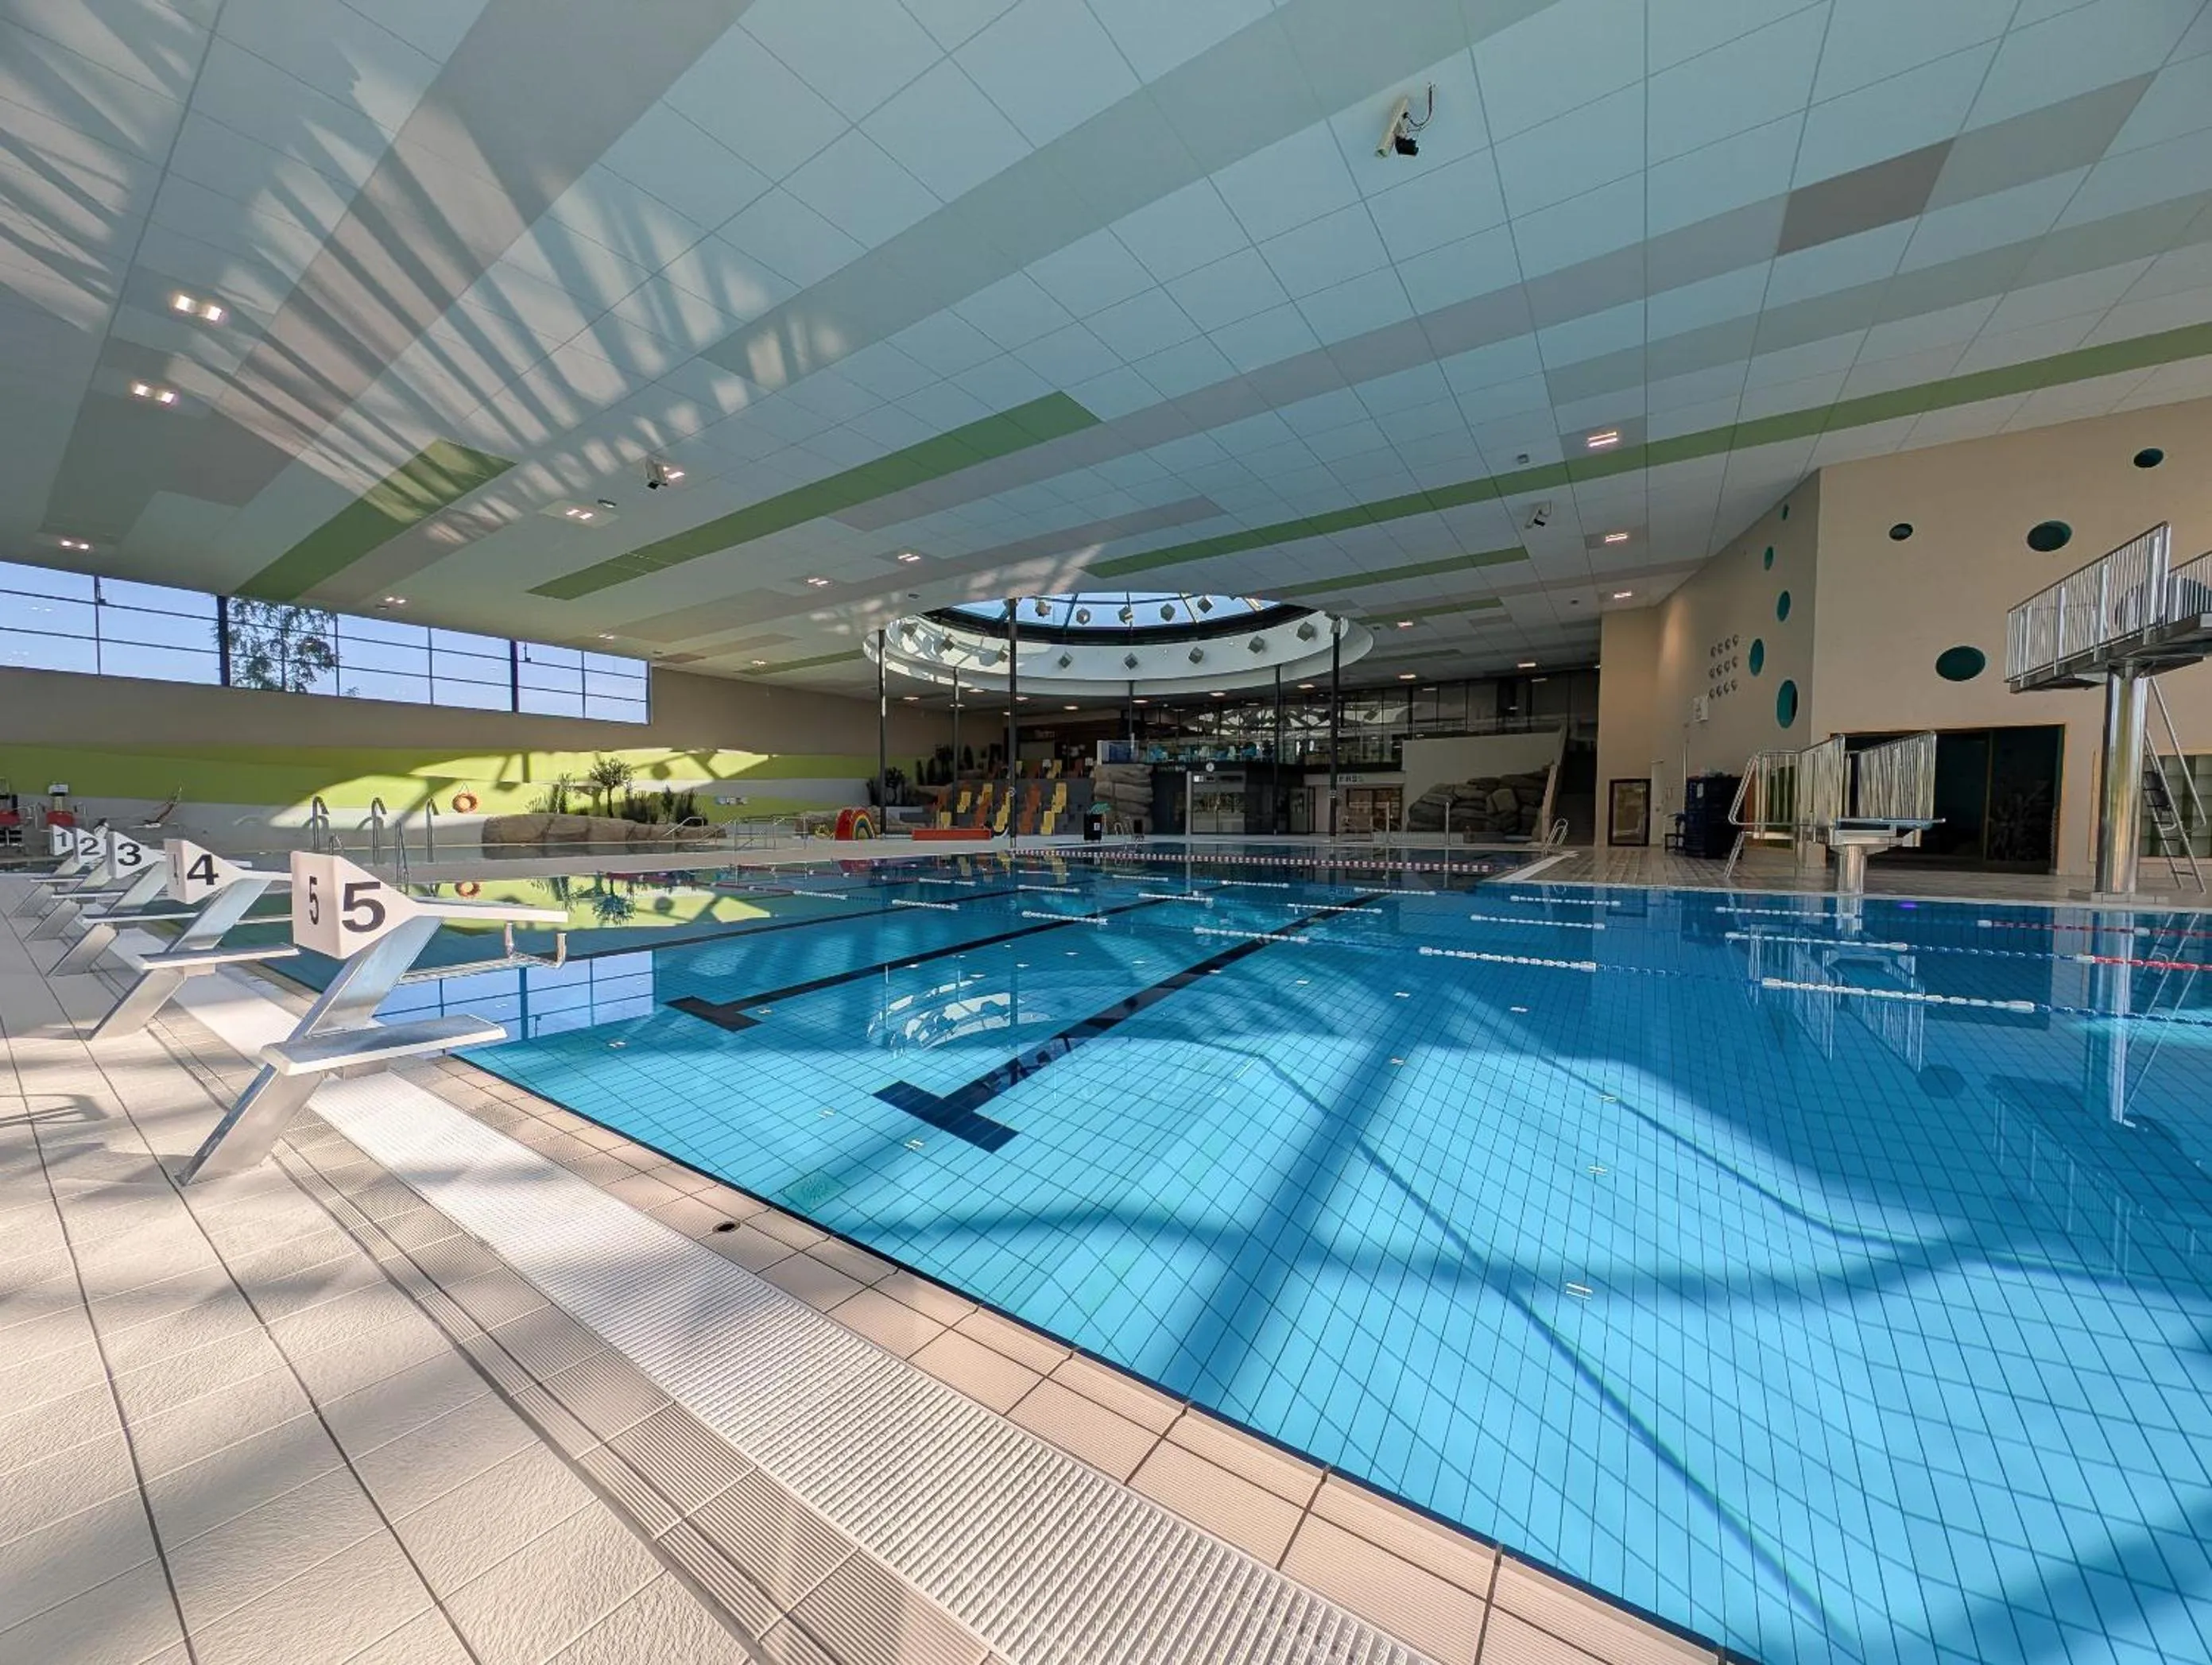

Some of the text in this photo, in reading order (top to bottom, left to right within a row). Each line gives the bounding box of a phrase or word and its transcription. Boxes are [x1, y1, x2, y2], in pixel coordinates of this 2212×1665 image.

[56, 832, 68, 847] 1
[79, 837, 100, 856] 2
[117, 842, 142, 866] 3
[187, 854, 219, 885] 4
[309, 875, 320, 925] 5
[342, 881, 385, 933] 5
